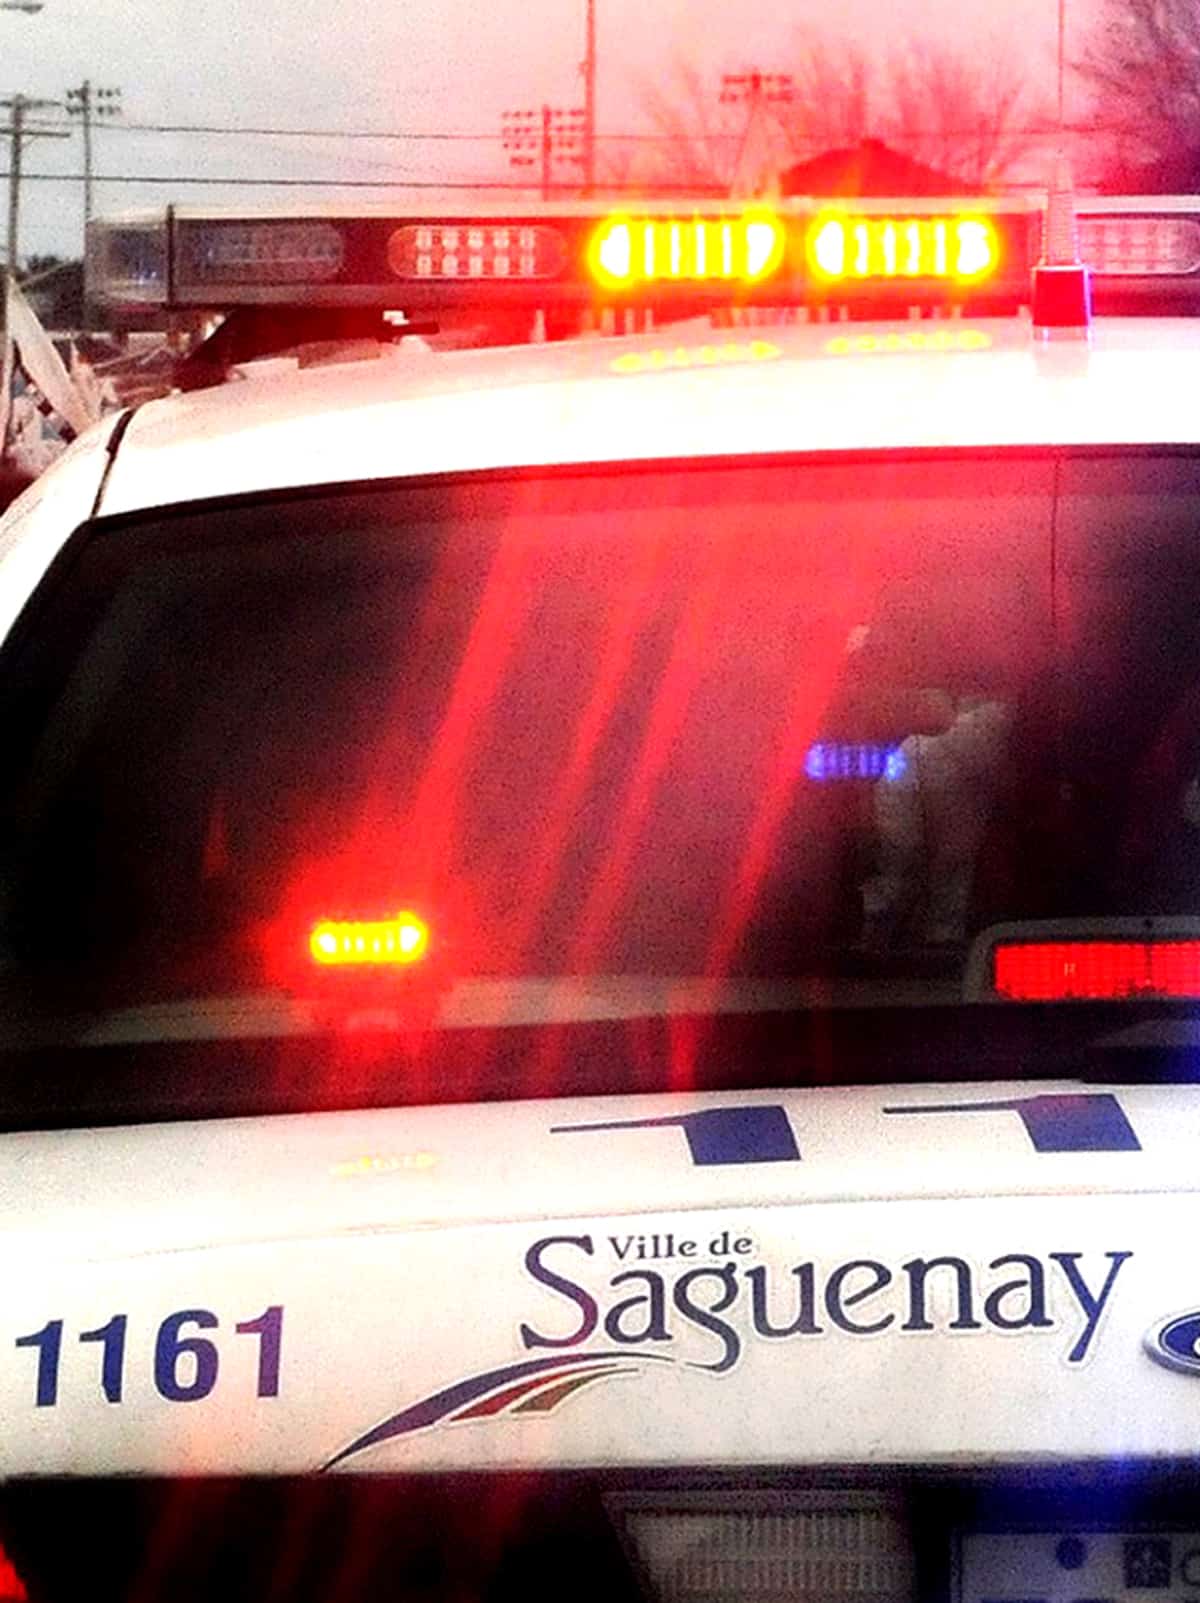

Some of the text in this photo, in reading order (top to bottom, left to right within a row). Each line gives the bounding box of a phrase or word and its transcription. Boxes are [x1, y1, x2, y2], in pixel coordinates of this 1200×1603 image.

[608, 1230, 753, 1261] Ville de
[520, 1235, 1134, 1373] Saguenay
[14, 1305, 285, 1408] 1161
